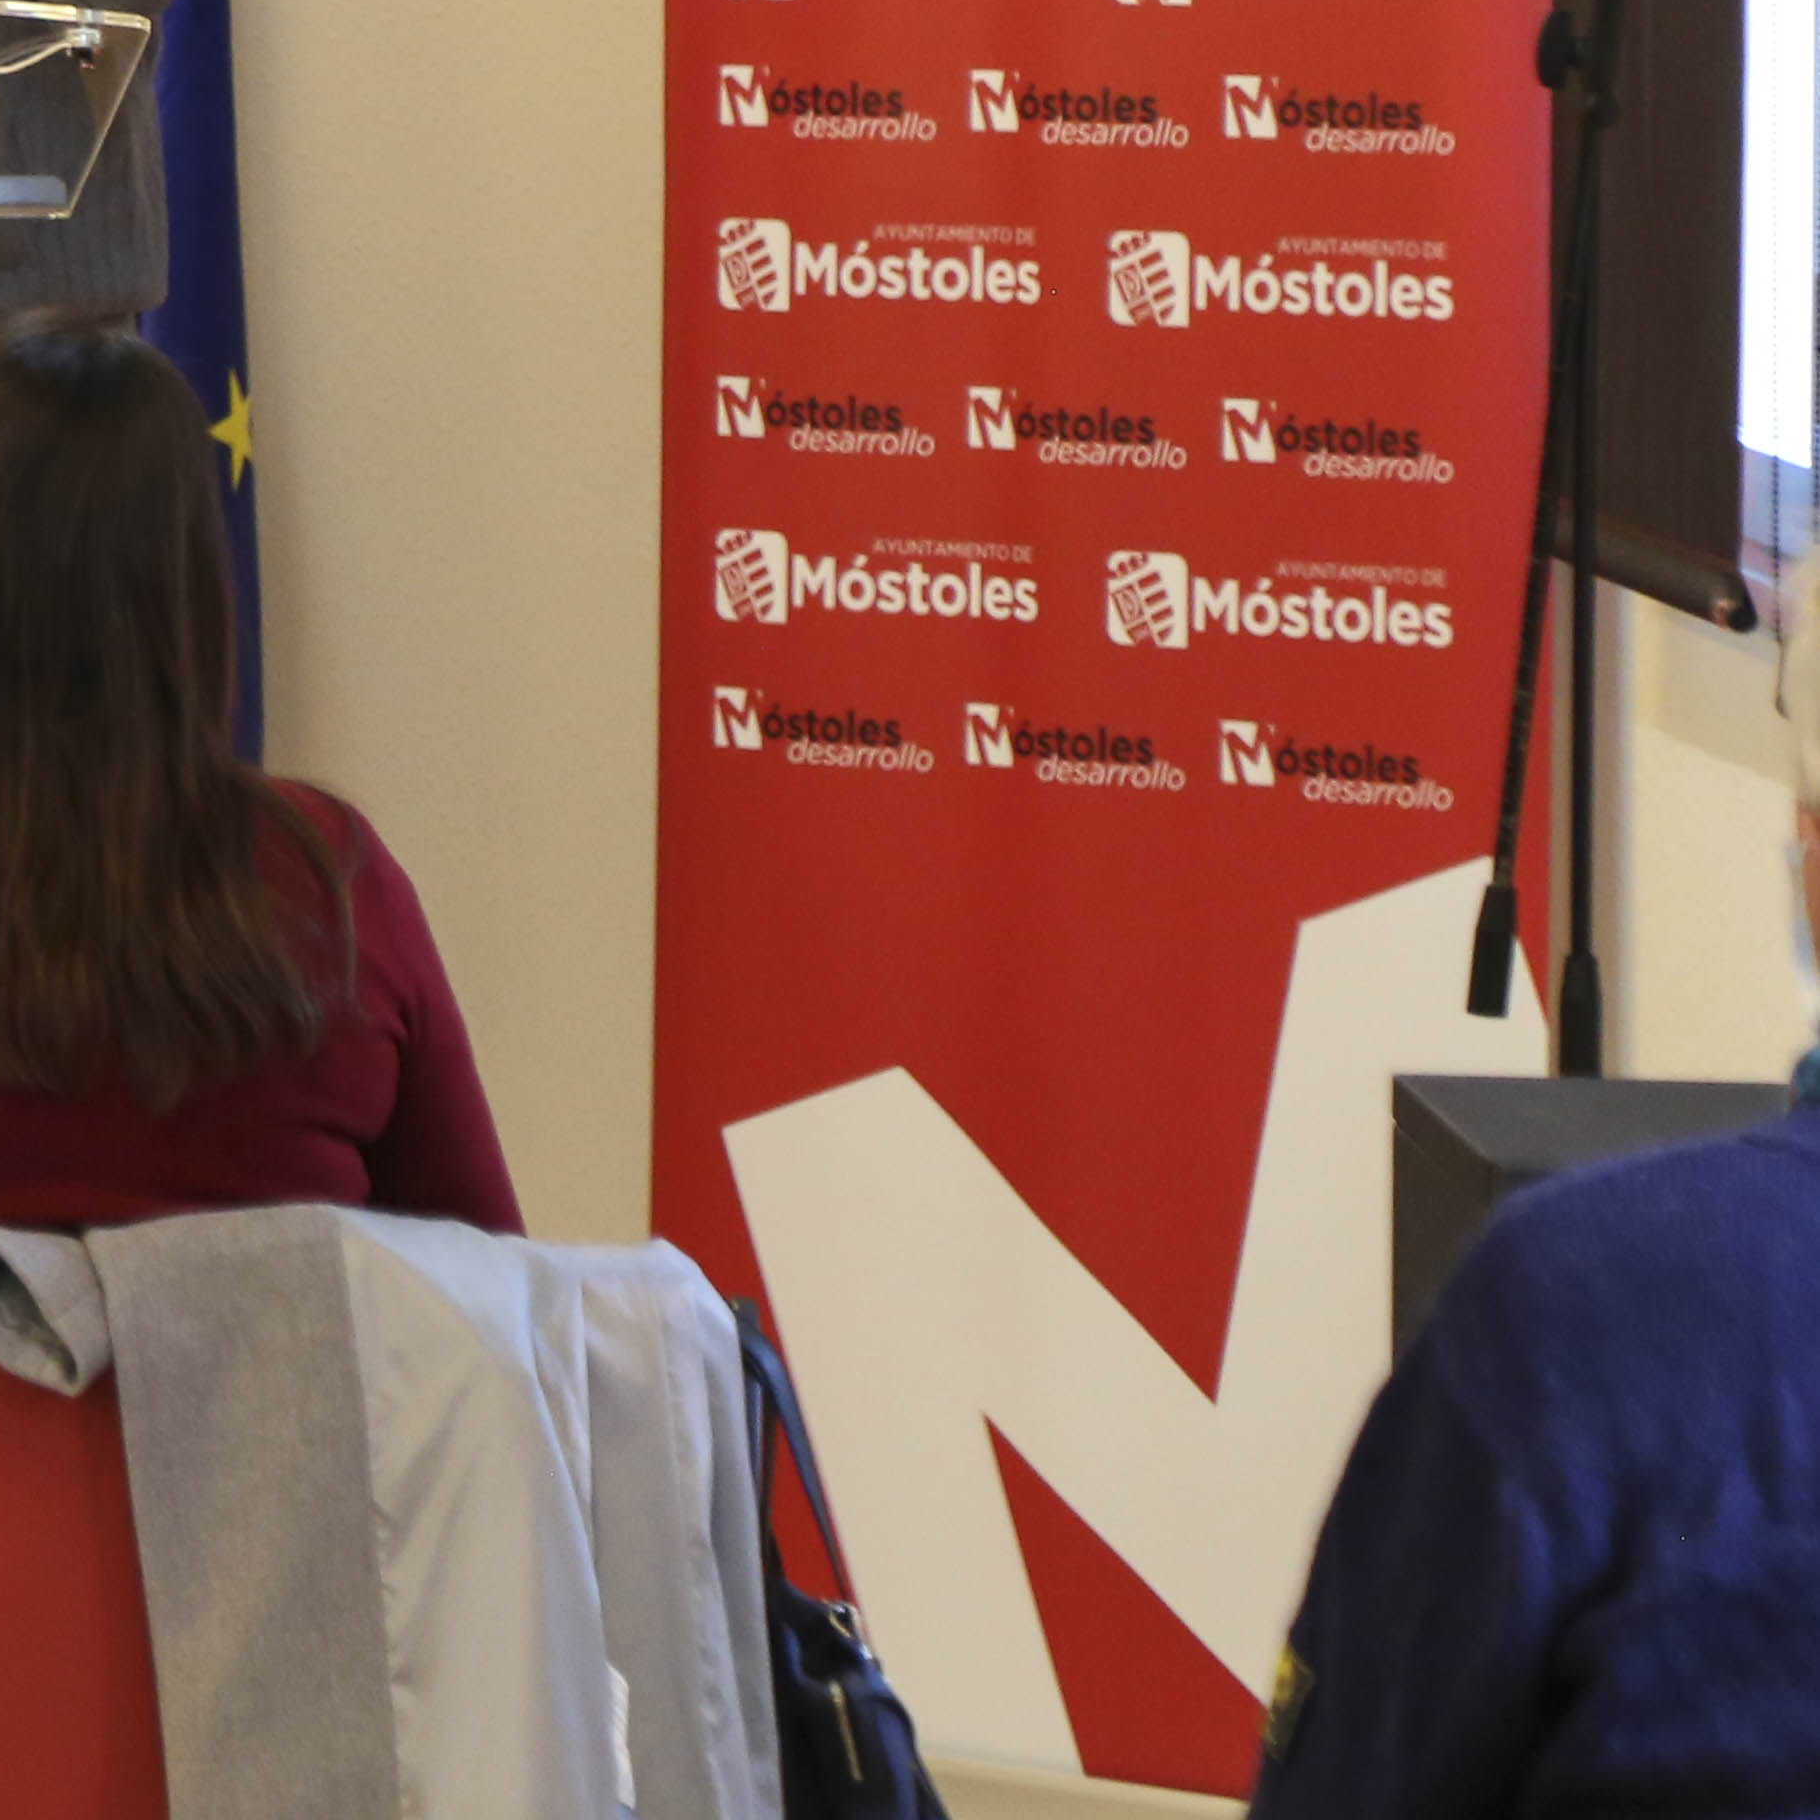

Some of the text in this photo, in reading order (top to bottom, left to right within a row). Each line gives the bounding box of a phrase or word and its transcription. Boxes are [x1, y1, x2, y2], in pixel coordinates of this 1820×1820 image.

[793, 111, 937, 141] desarrollo
[1042, 115, 1189, 148] desarrollo
[1305, 122, 1455, 155] desarrollo
[874, 223, 1010, 243] AYUNTAMIENTO
[1278, 237, 1420, 257] AYUNTAMIENTO
[794, 240, 1041, 304] Móstoles
[1194, 253, 1454, 321] Móstoles
[789, 425, 935, 457] desarrollo
[1039, 436, 1187, 471] desarrollo
[1303, 449, 1454, 484] desarrollo
[791, 554, 1039, 622] Móstoles
[1192, 576, 1454, 648] Móstoles
[786, 737, 934, 773] desarrollo
[1036, 755, 1186, 792] desarrollo
[1302, 773, 1454, 812] desarrollo
